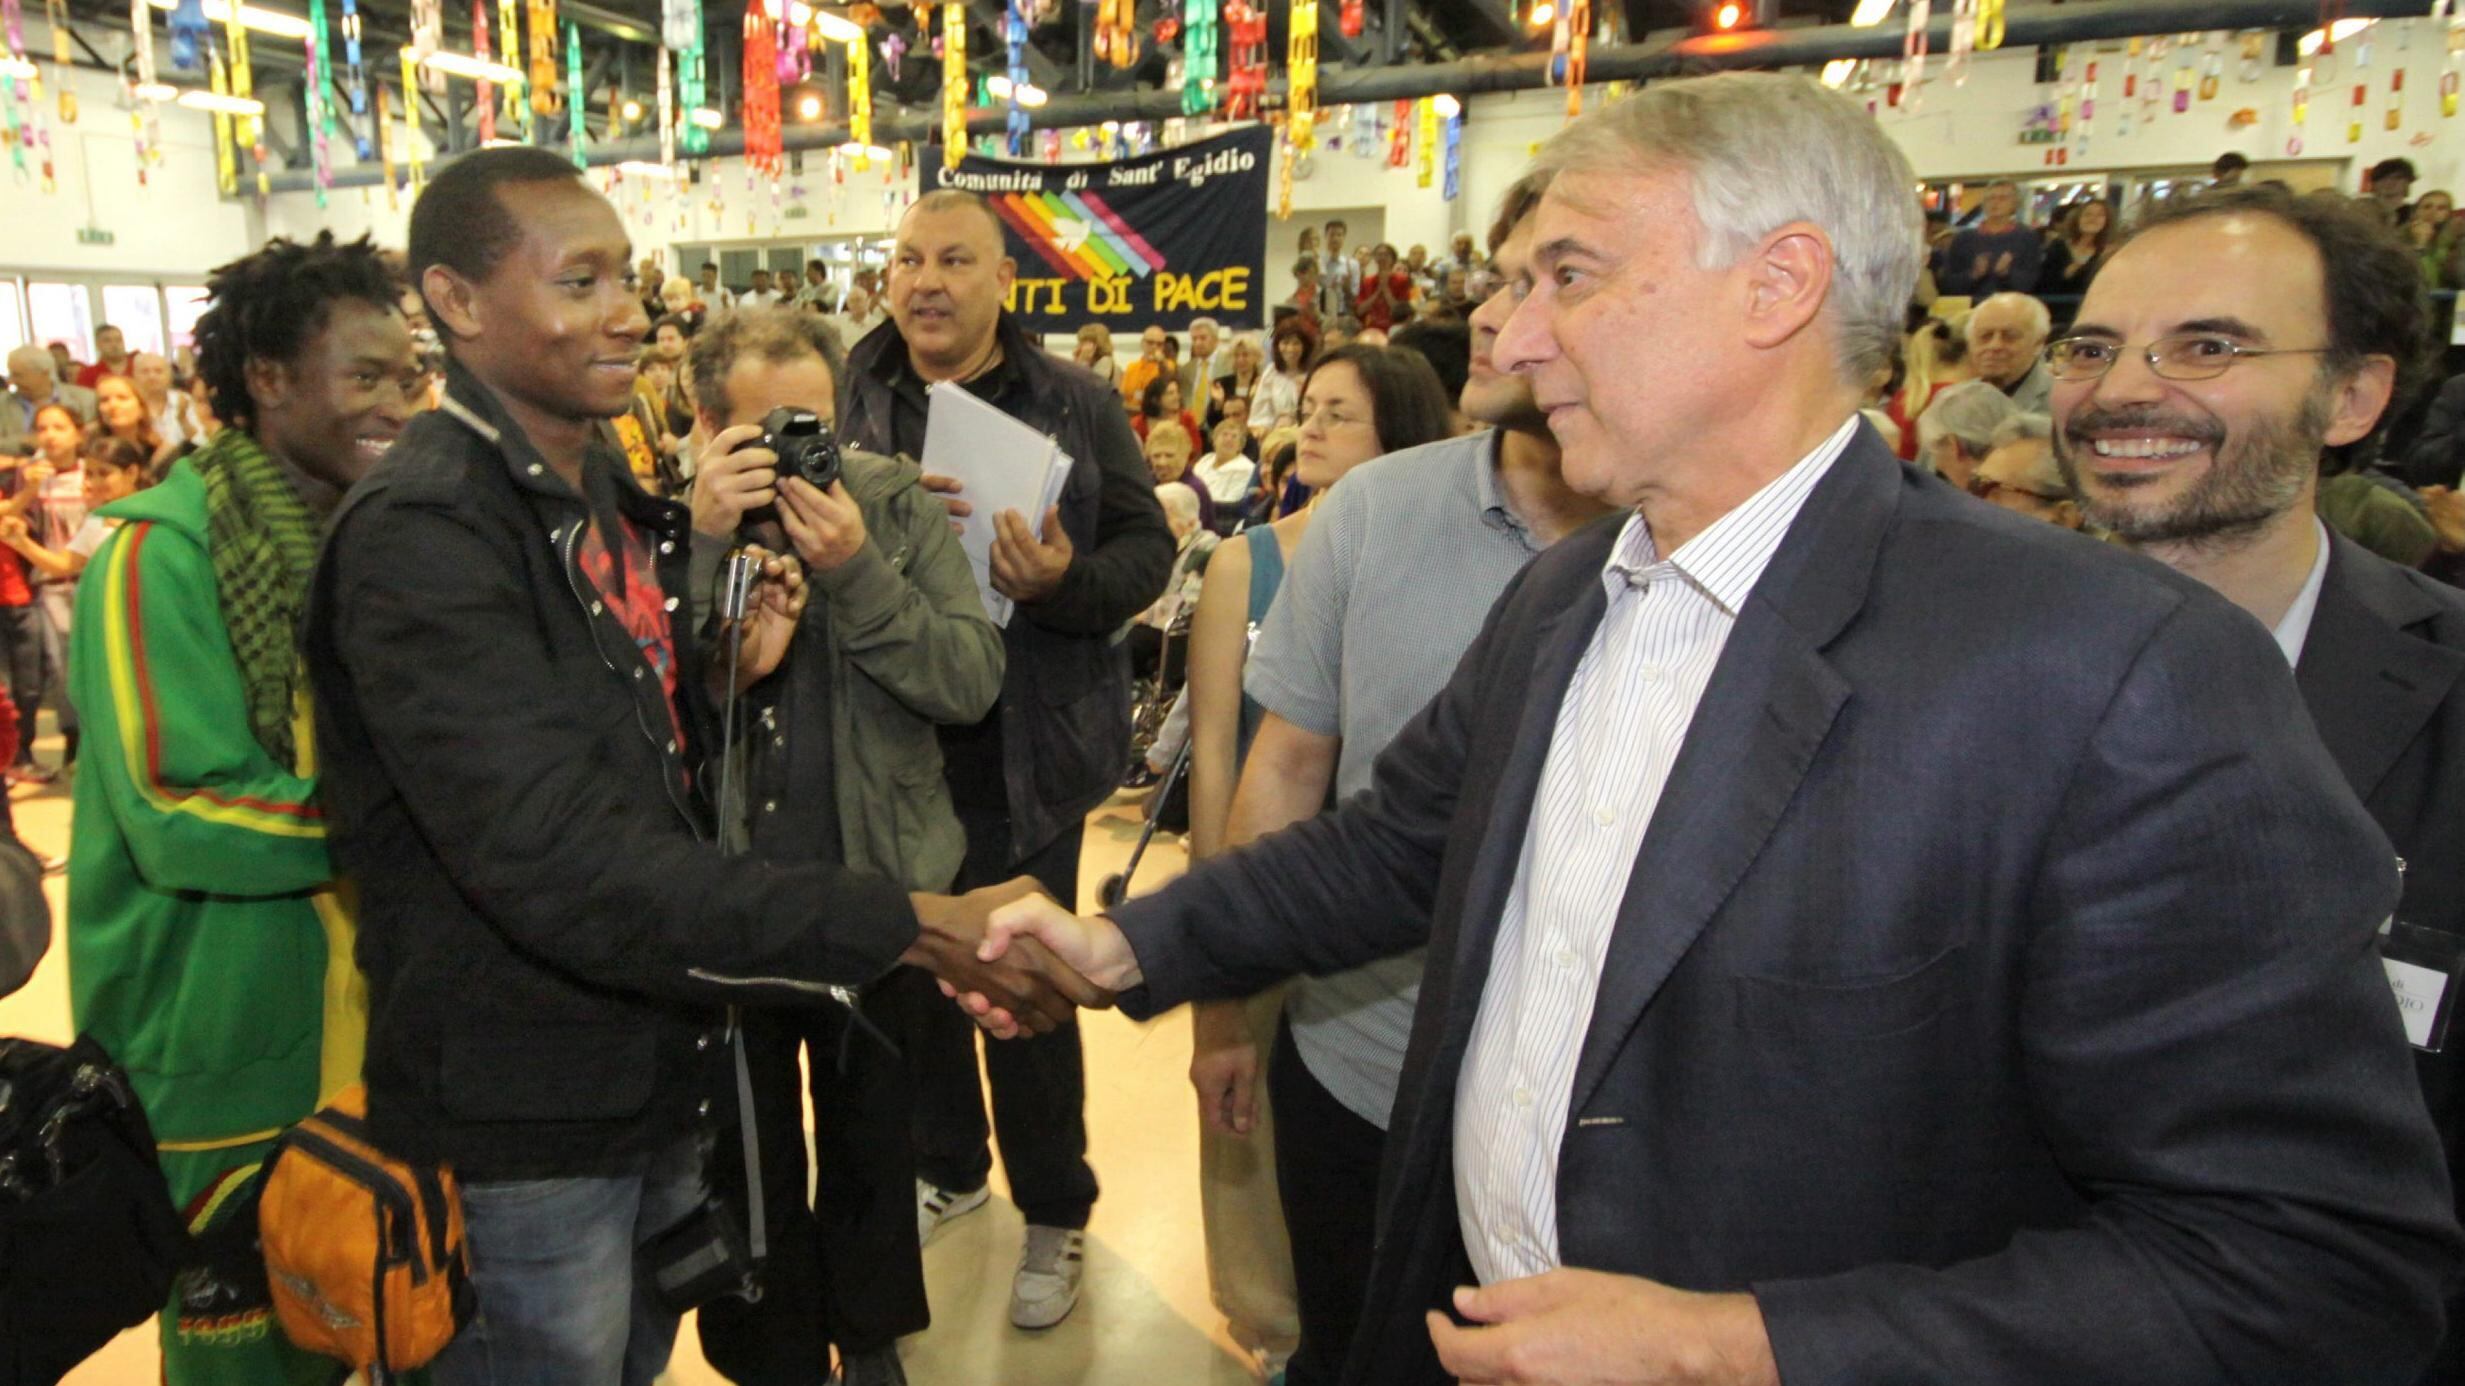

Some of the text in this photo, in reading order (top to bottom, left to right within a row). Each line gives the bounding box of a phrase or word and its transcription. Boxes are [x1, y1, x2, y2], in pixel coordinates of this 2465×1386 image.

[1065, 169, 1089, 189] di
[1108, 160, 1164, 186] Sant'
[1173, 147, 1255, 187] Egidio
[1087, 275, 1133, 314] DI
[1153, 266, 1251, 313] PACE
